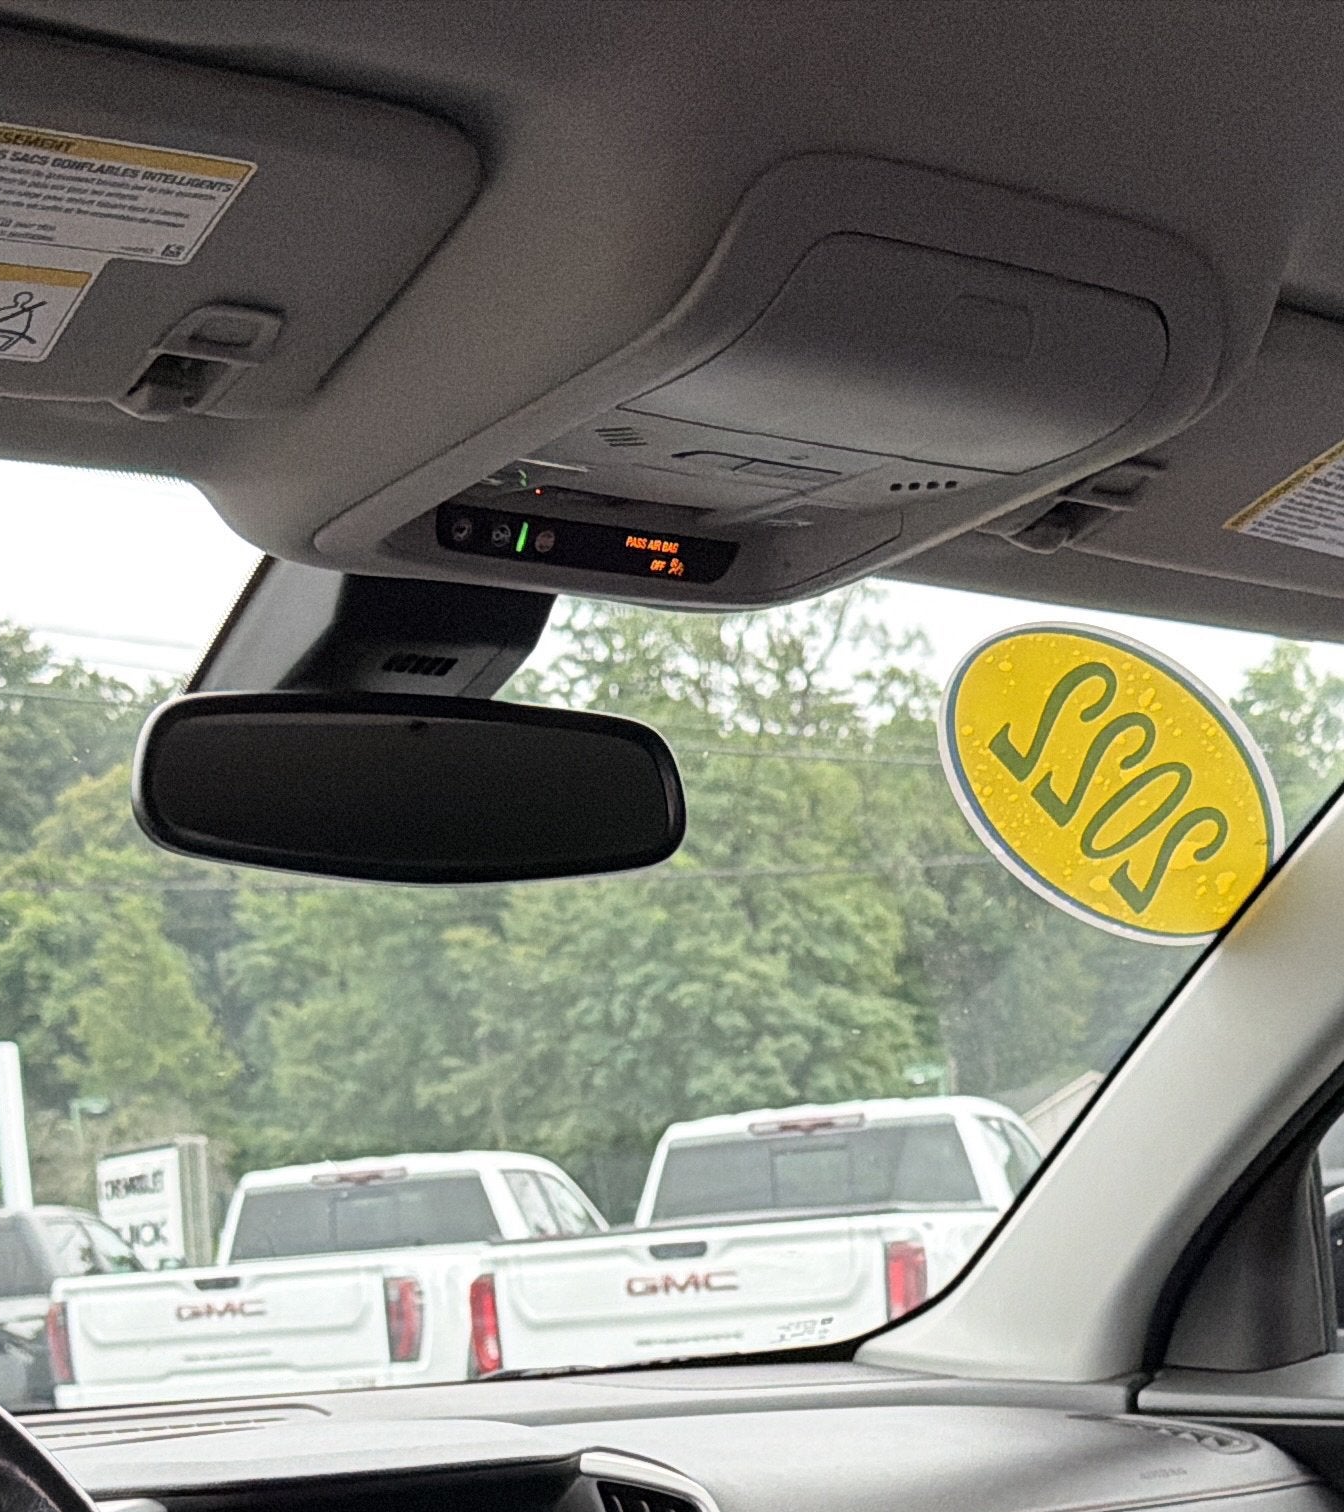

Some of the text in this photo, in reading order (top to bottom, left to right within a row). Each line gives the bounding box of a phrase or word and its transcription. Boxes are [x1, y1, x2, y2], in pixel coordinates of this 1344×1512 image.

[10, 151, 50, 166] SACS
[50, 156, 141, 179] GONFLABLES
[141, 169, 234, 193] INTELLIGENTS
[625, 535, 679, 554] PASS AIR BAG
[649, 559, 667, 571] OFF
[112, 1218, 170, 1248] UICK
[626, 1269, 740, 1297] GMC
[176, 1298, 268, 1322] GMC
